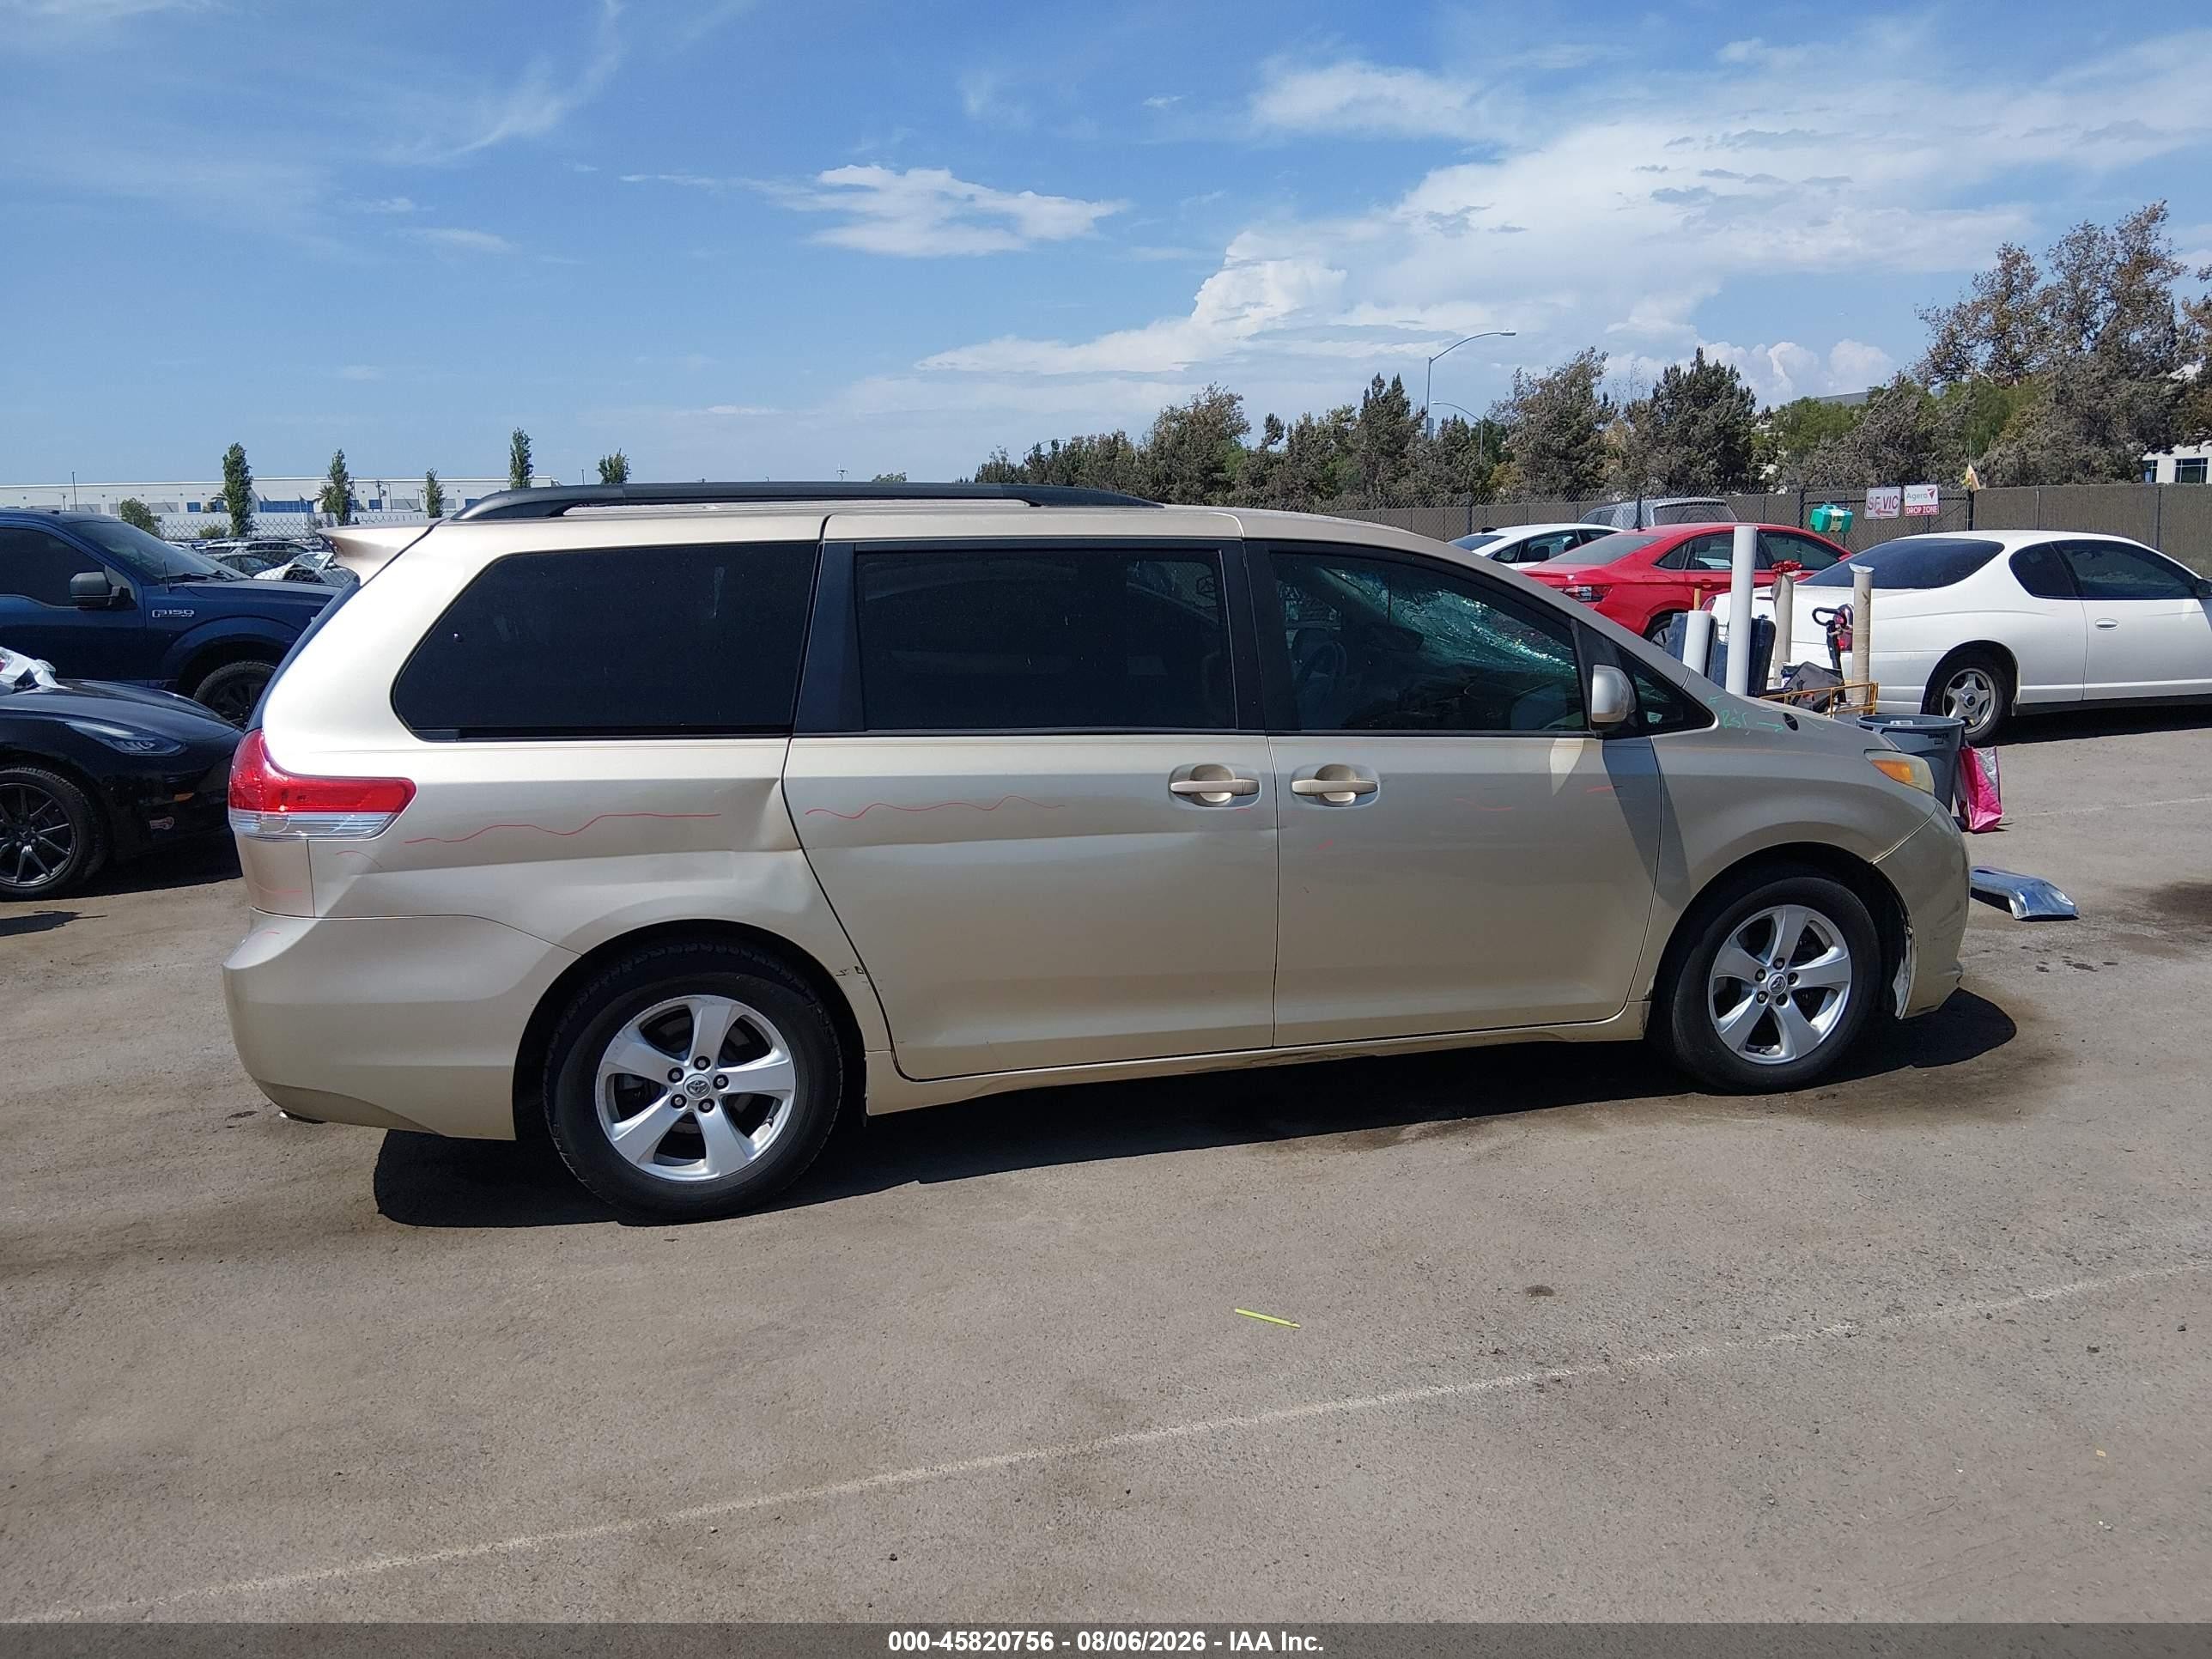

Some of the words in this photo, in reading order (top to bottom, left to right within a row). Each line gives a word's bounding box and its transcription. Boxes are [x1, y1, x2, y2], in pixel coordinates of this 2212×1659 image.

[1868, 496, 1881, 511] SF
[1882, 495, 1899, 510] VIC
[1923, 505, 1938, 514] ZONE
